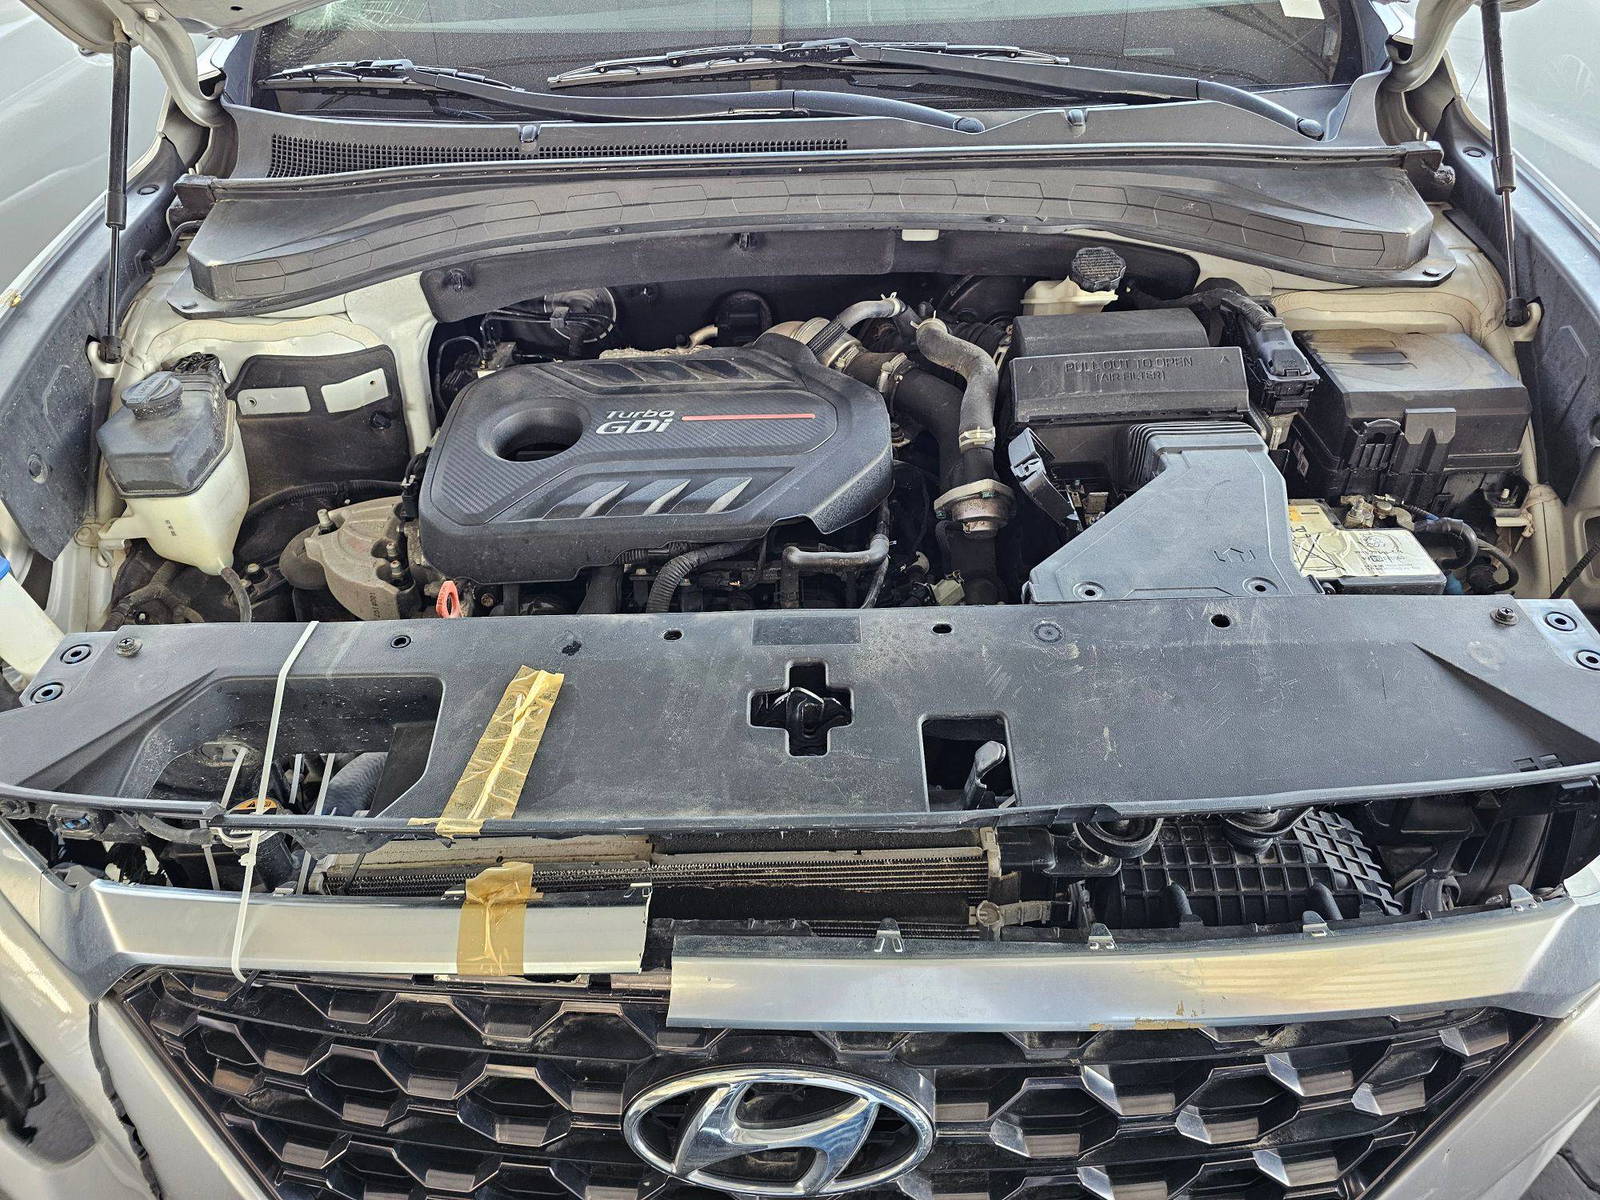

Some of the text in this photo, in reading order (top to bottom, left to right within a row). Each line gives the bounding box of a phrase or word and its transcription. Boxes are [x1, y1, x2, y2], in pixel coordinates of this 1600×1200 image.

[1064, 356, 1193, 373] PULL OUT TO OPEN
[606, 409, 675, 419] Turbo
[595, 418, 674, 434] GDi
